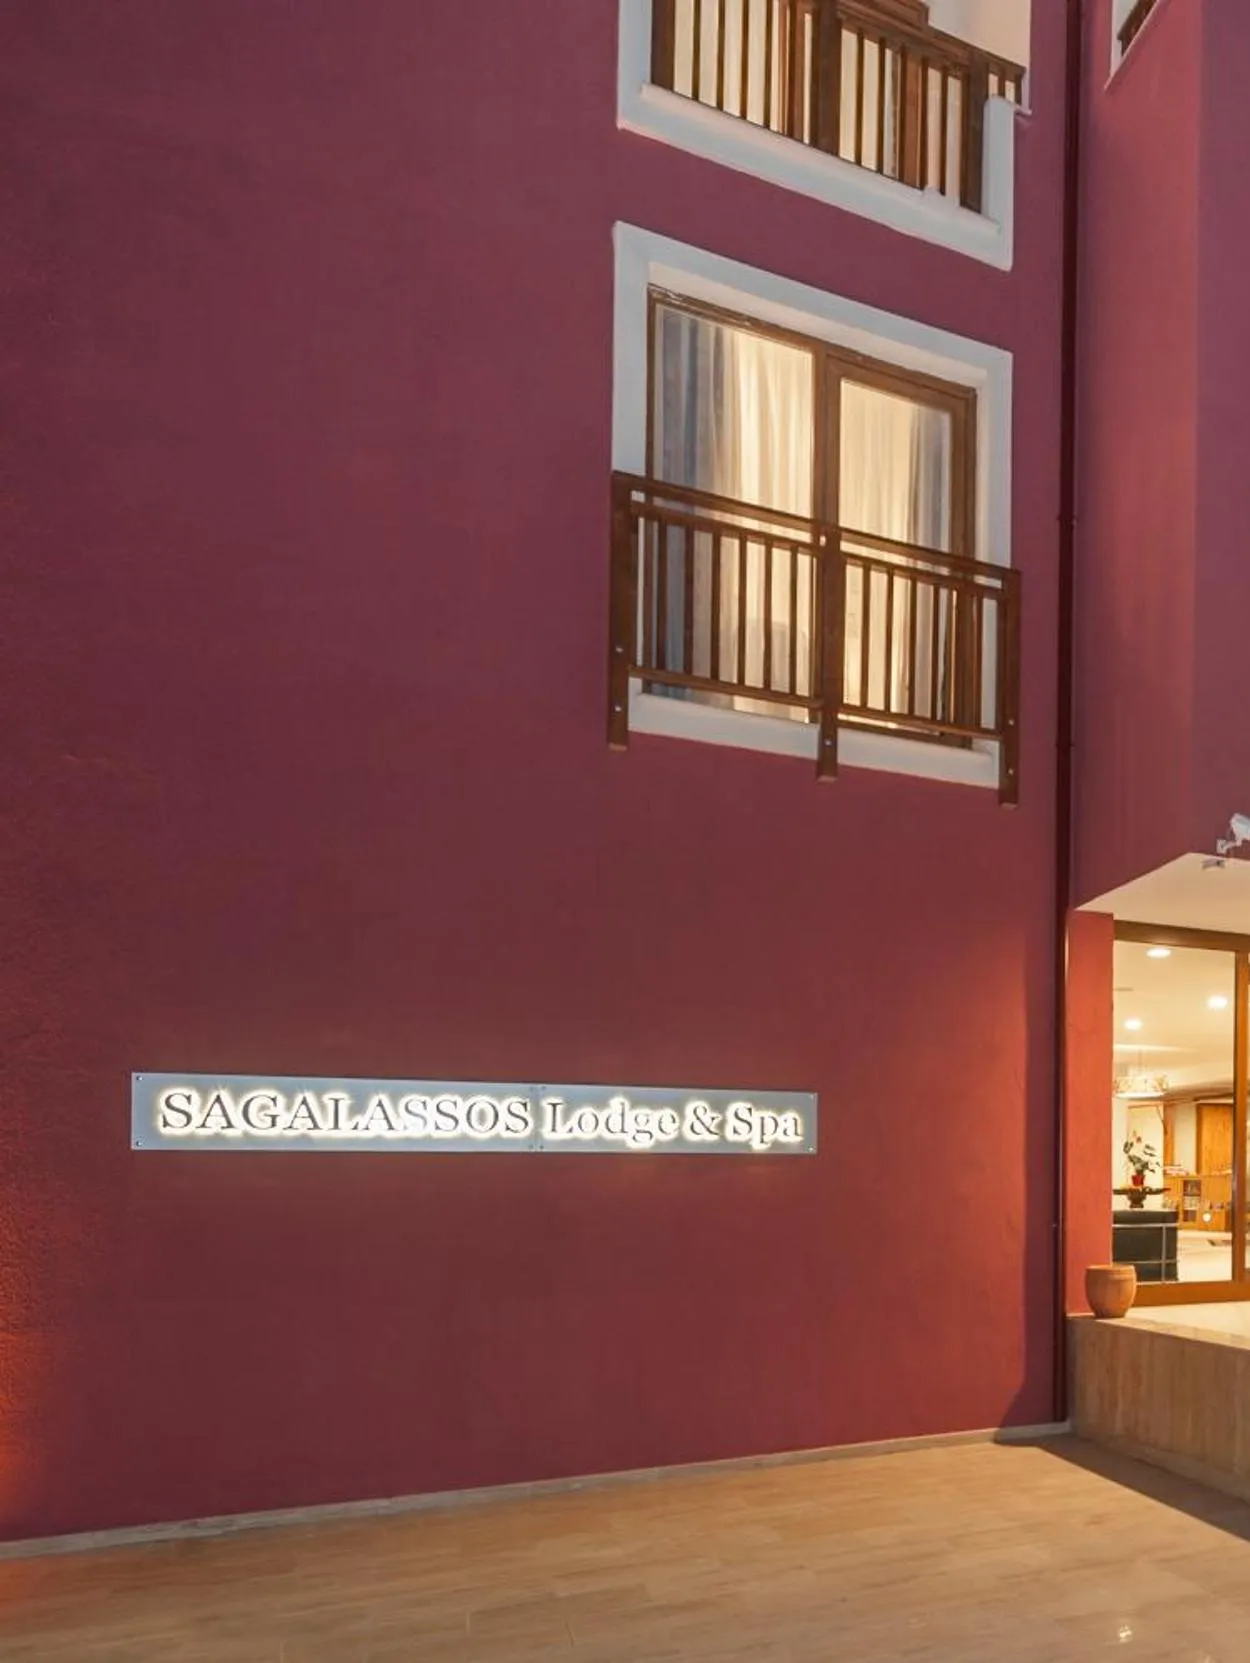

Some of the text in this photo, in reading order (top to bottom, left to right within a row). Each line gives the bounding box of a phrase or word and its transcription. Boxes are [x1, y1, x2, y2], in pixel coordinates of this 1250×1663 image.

[161, 1091, 801, 1145] SAGALASSOS Lodge & Spa
